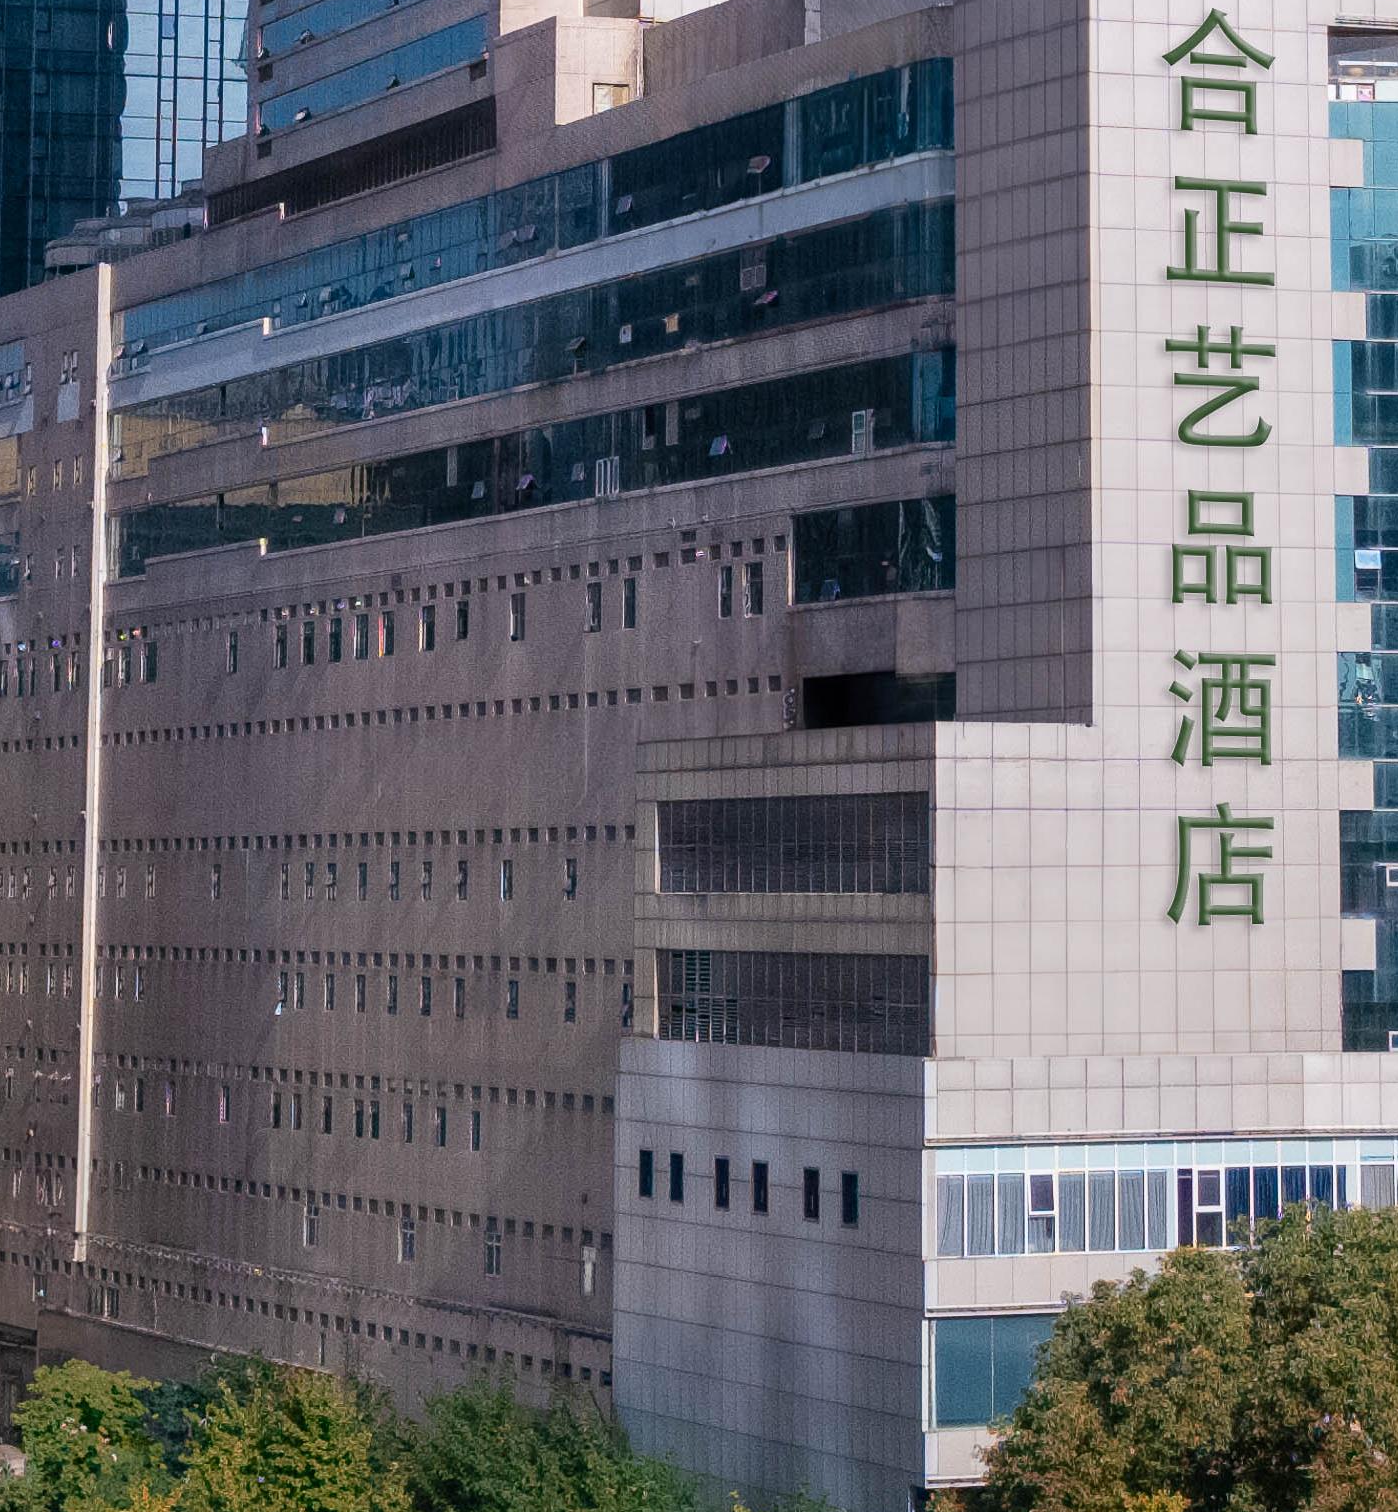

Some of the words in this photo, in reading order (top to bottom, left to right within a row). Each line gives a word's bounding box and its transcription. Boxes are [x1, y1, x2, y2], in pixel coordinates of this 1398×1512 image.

[1162, 7, 1276, 927] 合正艺品酒店
